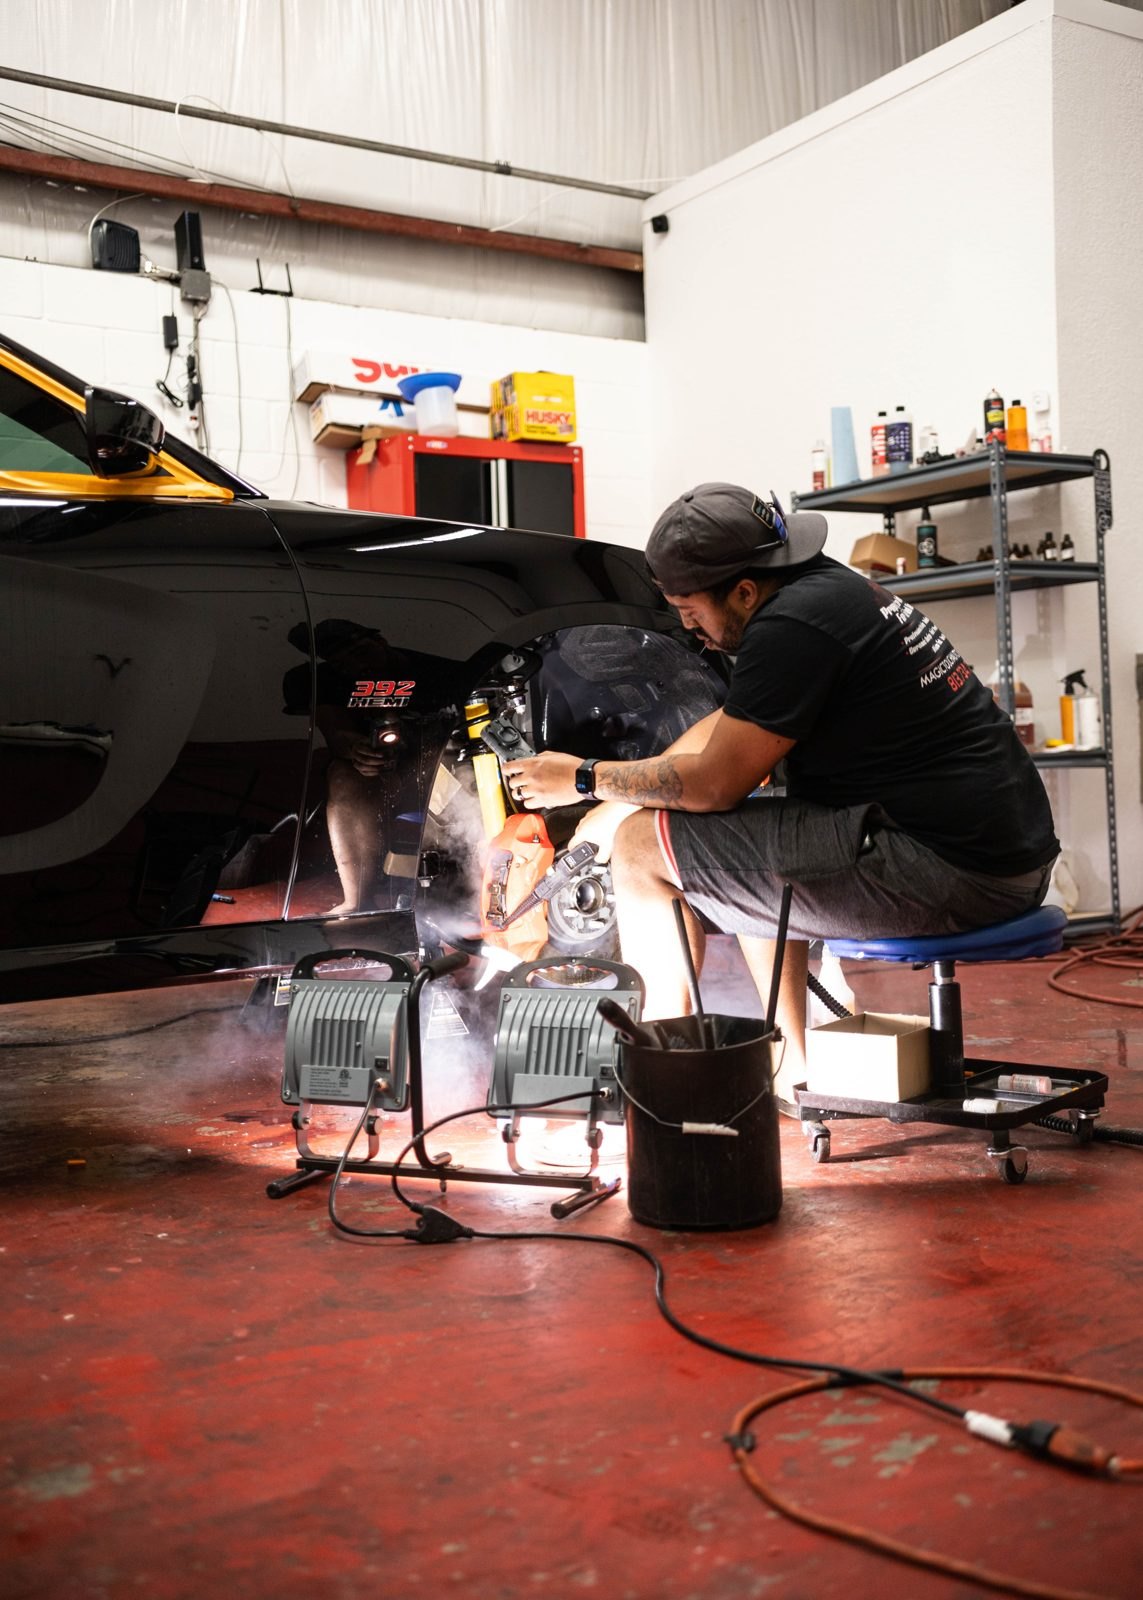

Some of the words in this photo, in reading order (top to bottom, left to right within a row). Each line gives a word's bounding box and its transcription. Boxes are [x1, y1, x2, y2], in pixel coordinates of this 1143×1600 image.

[525, 409, 573, 426] HUSKY
[352, 681, 416, 697] 392
[347, 697, 410, 708] HEMI
